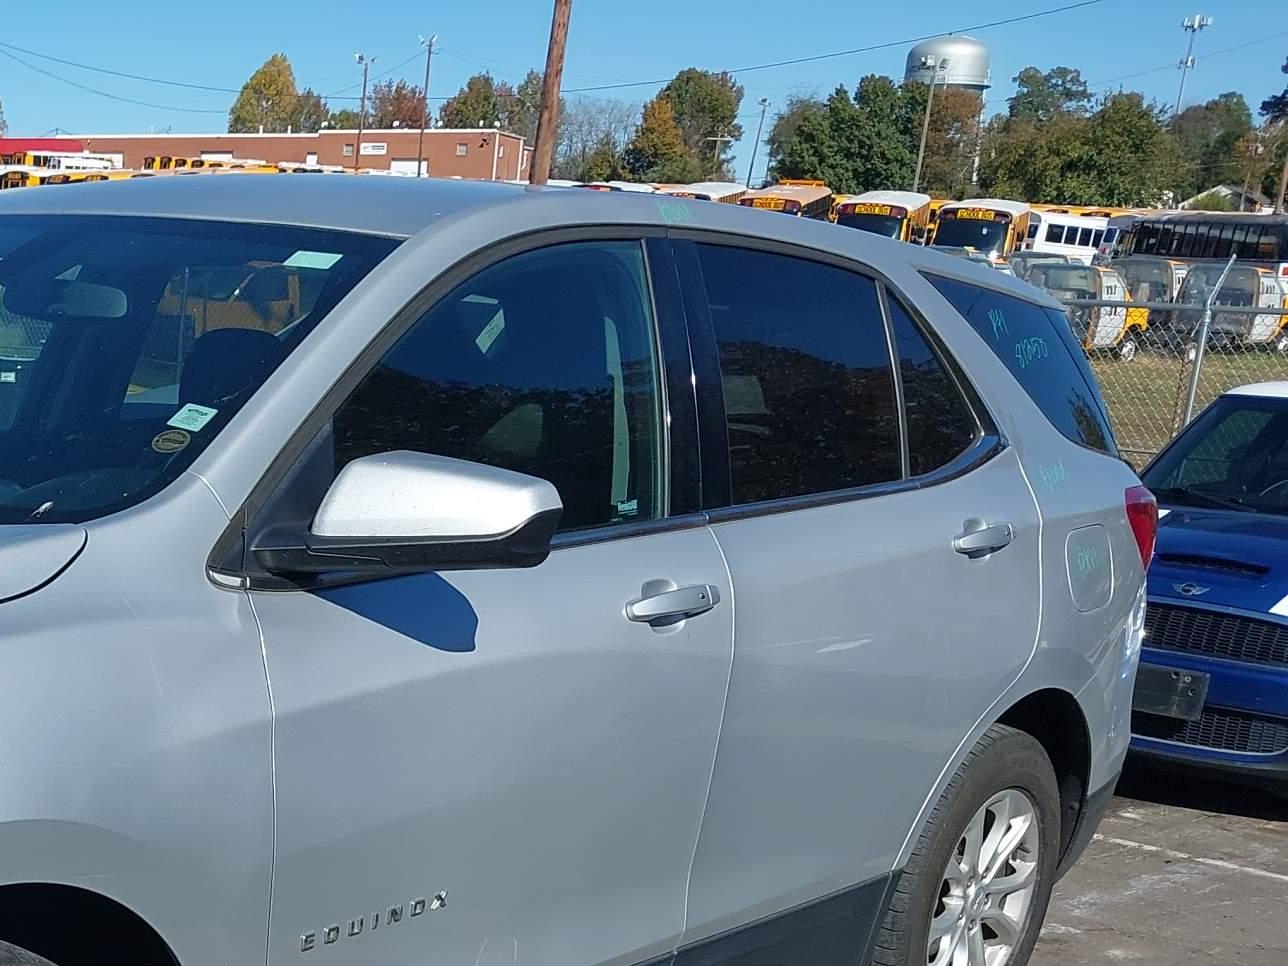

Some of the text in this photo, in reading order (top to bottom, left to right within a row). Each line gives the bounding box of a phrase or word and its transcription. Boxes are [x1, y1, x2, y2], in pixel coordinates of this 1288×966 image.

[857, 205, 889, 215] SCHOOL BUS
[959, 210, 995, 220] SCHOOL BUS
[299, 889, 448, 953] EQUINOX
